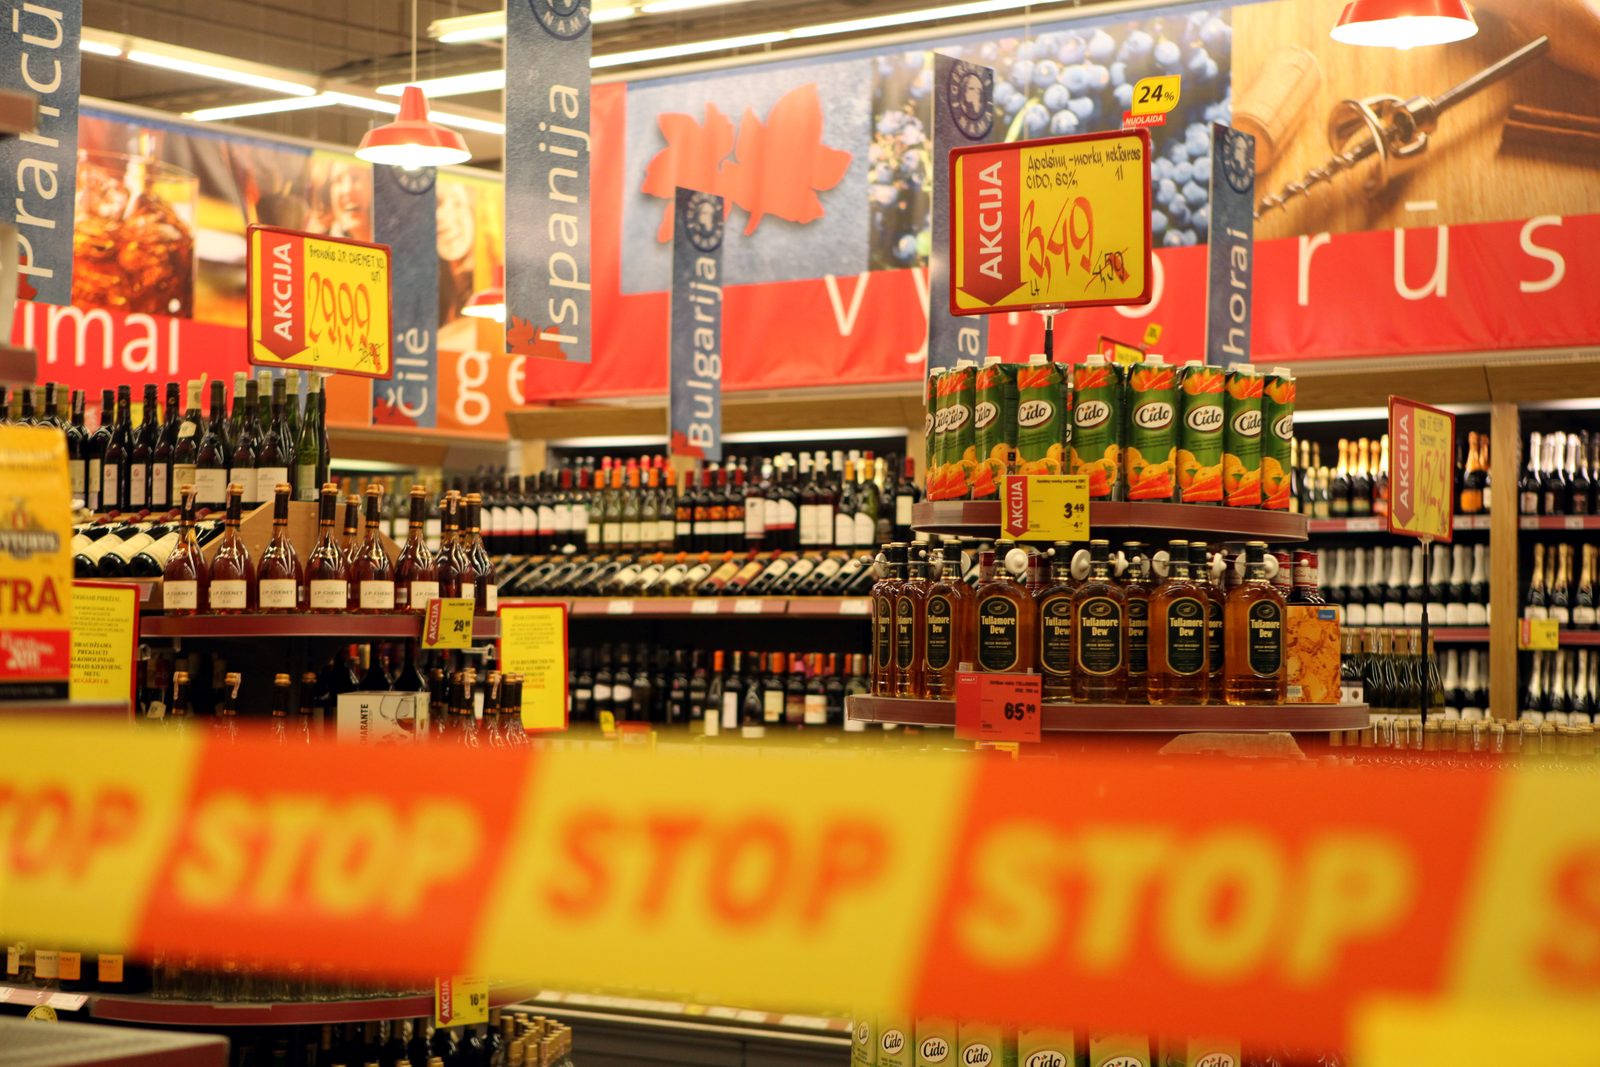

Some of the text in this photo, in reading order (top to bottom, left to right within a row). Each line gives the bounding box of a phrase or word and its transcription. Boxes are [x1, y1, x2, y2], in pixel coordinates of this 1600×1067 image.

[1125, 115, 1163, 125] NUOLAIDA
[539, 83, 591, 344] Ispanija
[979, 160, 1002, 280] AKCIJA
[273, 243, 292, 342] AKCIJA
[22, 298, 181, 375] imai
[686, 256, 723, 448] Bulgarija
[386, 327, 430, 417] Čilė
[1018, 405, 1047, 422] Cido
[1076, 405, 1104, 422] Cido
[1139, 407, 1170, 424] Cido
[1192, 407, 1222, 426] Cido
[1400, 414, 1409, 509] AKCIJA
[1011, 481, 1023, 528] AKCIJA
[429, 603, 439, 640] AKCIJA
[454, 619, 464, 632] 29
[981, 615, 1015, 625] Tullamore
[1082, 616, 1119, 627] Tullamore
[1170, 617, 1203, 628] Tullamore
[1251, 619, 1281, 629] Tullamore
[990, 625, 1006, 635] Dew
[1054, 627, 1070, 636] Dew
[1092, 626, 1109, 636] Dew
[1179, 628, 1195, 637] Dew
[1259, 628, 1273, 638] Dew
[1004, 702, 1025, 721] 65
[178, 794, 480, 914] STOP
[546, 811, 889, 932] STOP
[956, 819, 1411, 981] STOP
[883, 1033, 902, 1050] Cido
[923, 1041, 946, 1058] Cido
[966, 1047, 989, 1065] Cido
